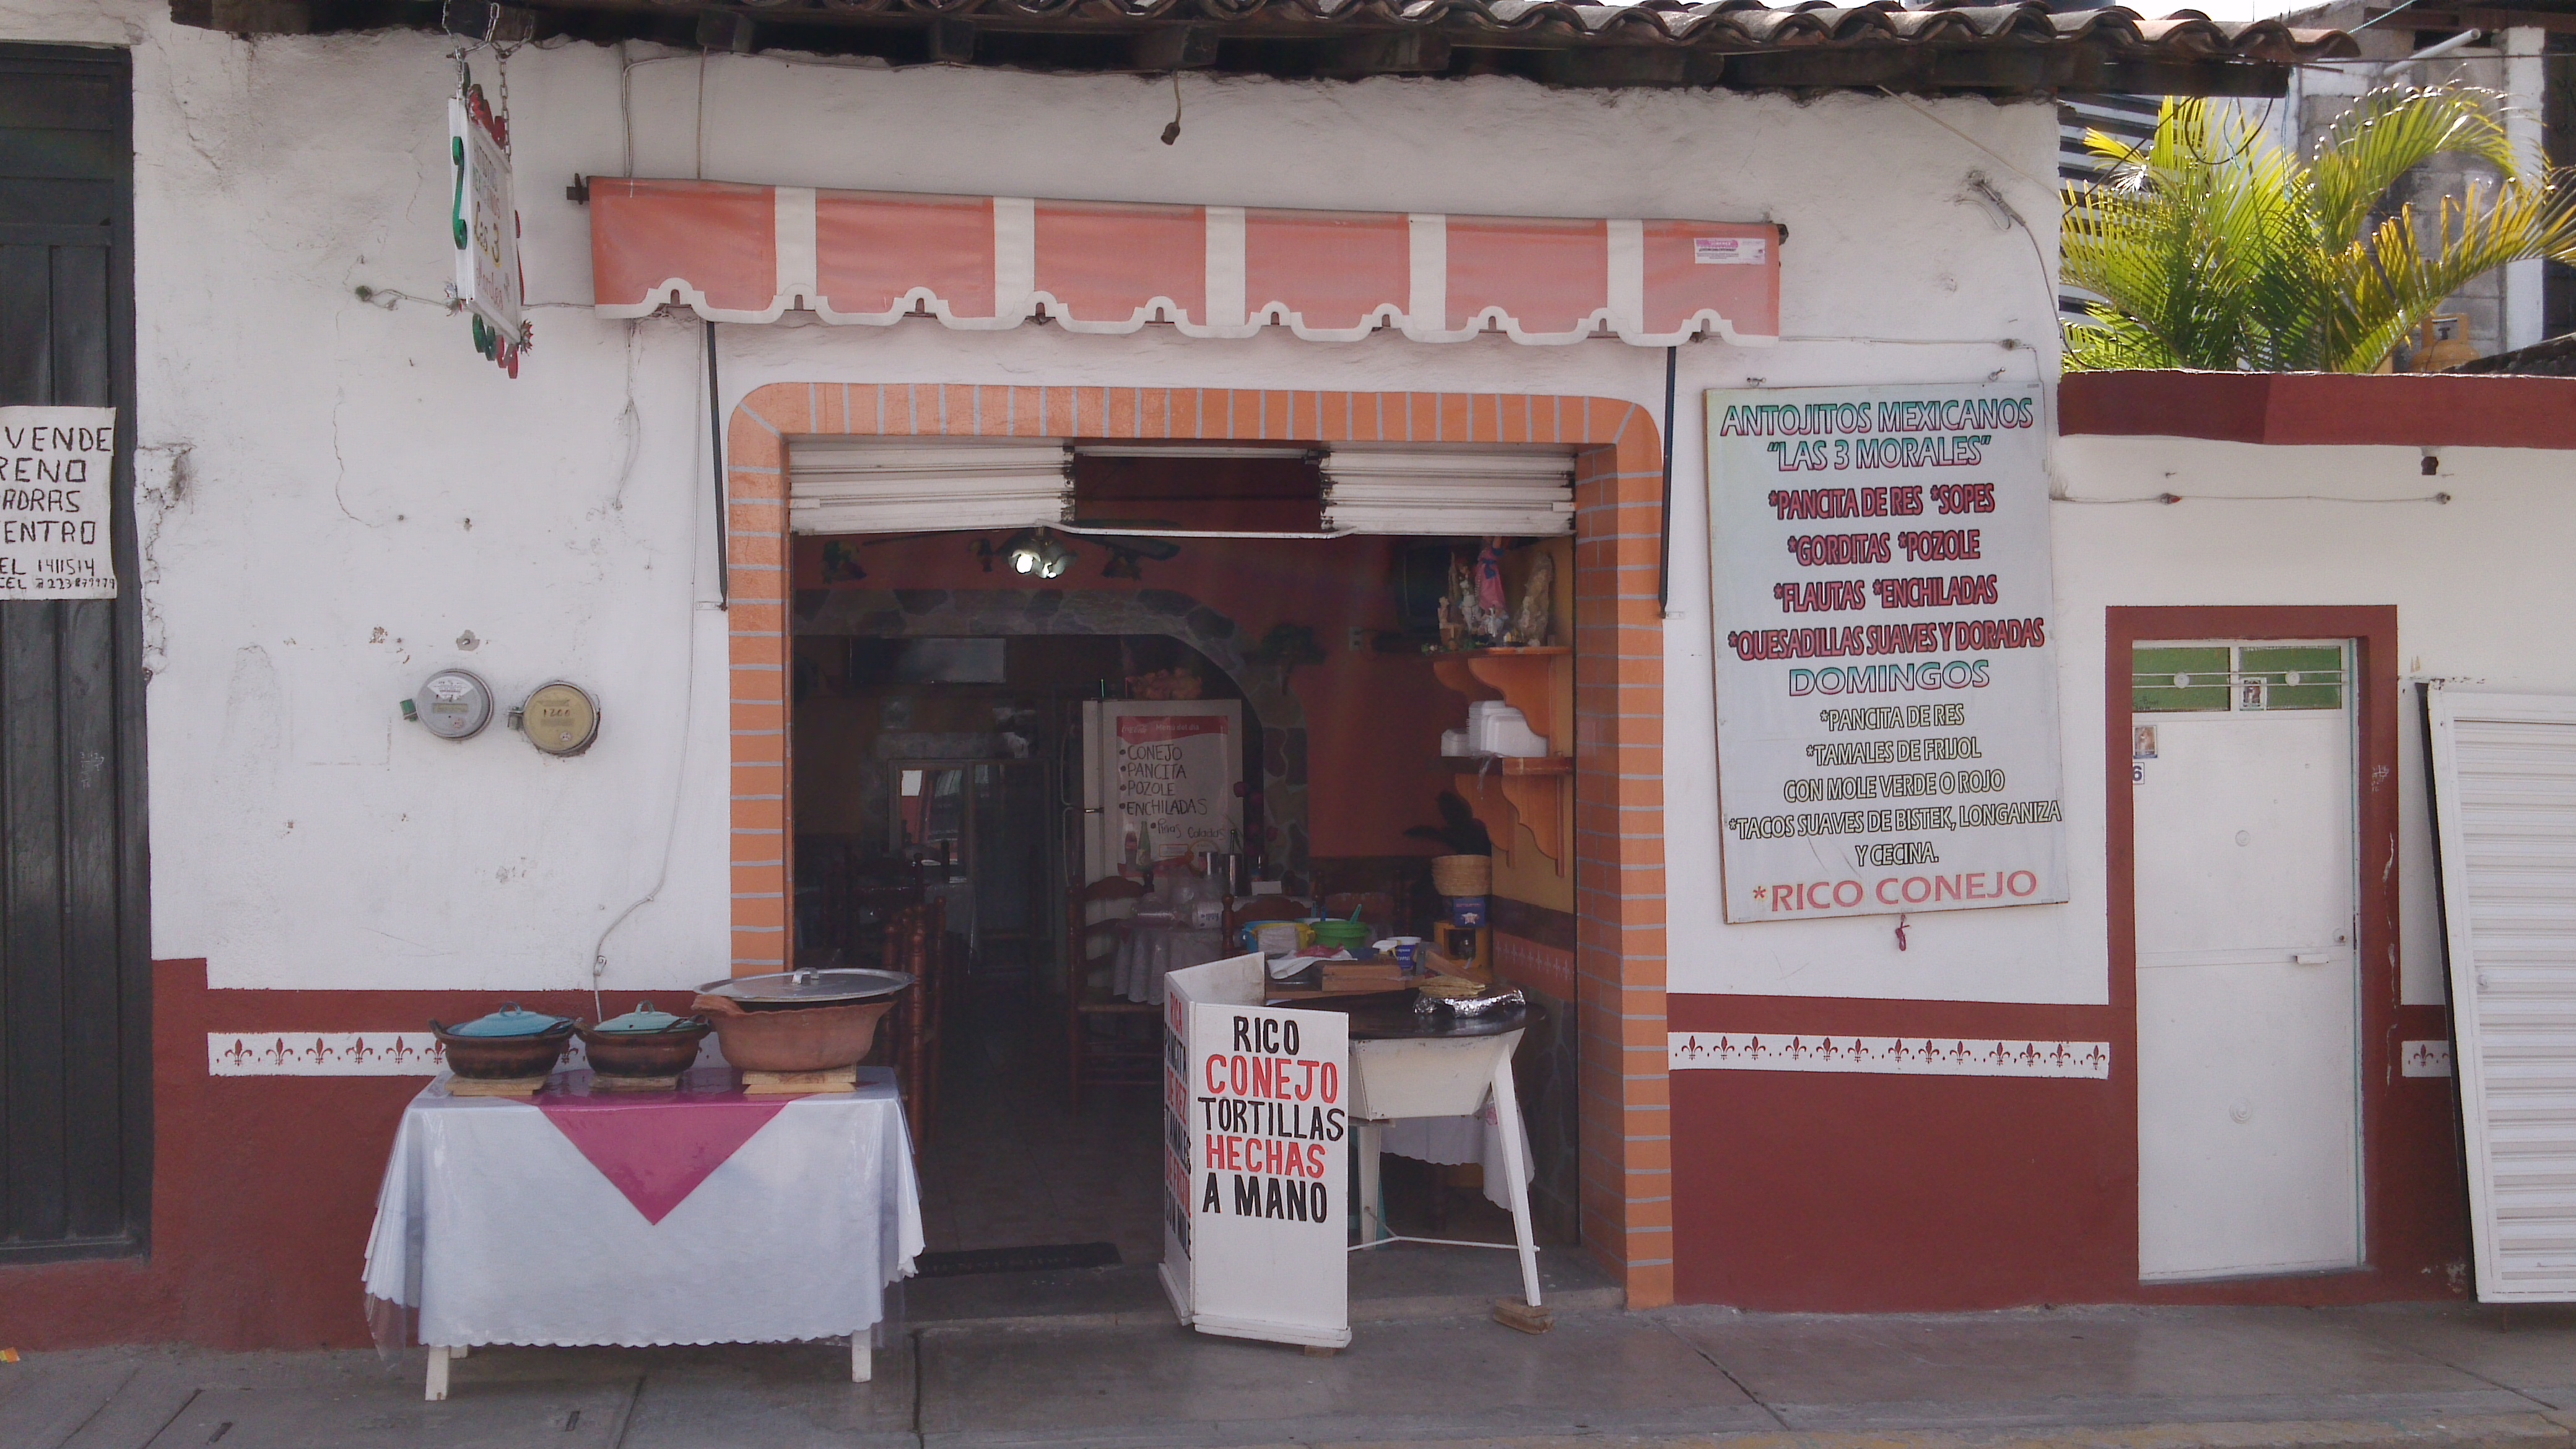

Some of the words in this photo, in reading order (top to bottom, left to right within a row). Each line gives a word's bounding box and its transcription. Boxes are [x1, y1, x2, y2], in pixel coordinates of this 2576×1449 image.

[1720, 402, 1872, 437] ANTOJITOS
[1878, 398, 2034, 432] MEXICANOS
[5, 426, 112, 451] VENDE
[1834, 439, 1849, 469] 3
[3, 489, 80, 512] ADRAS
[1861, 487, 1888, 517] DE
[1890, 485, 1923, 516] RES
[38, 557, 94, 577] 1411514
[1866, 622, 1938, 655] SUAVES
[1934, 621, 1953, 651] Y
[1955, 618, 2045, 650] DORADAS
[1789, 659, 1990, 697] DOMINGOS
[1907, 705, 1931, 728] DE
[1933, 703, 1965, 726] RES
[1128, 744, 1182, 761] CONEJO
[1897, 740, 1921, 762] DE
[1923, 736, 1982, 761] FRIJOL
[1128, 762, 1186, 780] PANCITA
[1784, 780, 1823, 803] CON
[1827, 777, 1877, 801] MOLE
[1879, 773, 1937, 798] VERDE
[1939, 772, 1956, 795] O
[1958, 769, 2005, 793] ROJO
[1128, 780, 1175, 796] POZOLE
[1126, 798, 1207, 816] ENCHILADAS
[1798, 811, 1864, 837] SUAVES
[1866, 809, 1892, 833] DE
[1895, 806, 1957, 832] BISTEK,
[1959, 801, 2063, 828] LONGANIZA
[1855, 845, 1869, 867] Y
[1869, 842, 1939, 866] CECINA.
[1876, 870, 2037, 905] CONEJO
[1234, 1016, 1300, 1055] RICO
[1206, 1054, 1338, 1104] CONEJO
[1198, 1097, 1345, 1141] TORTILLAS
[1206, 1134, 1326, 1179] HECHAS
[1202, 1172, 1222, 1214] A
[1234, 1174, 1328, 1223] MANO
